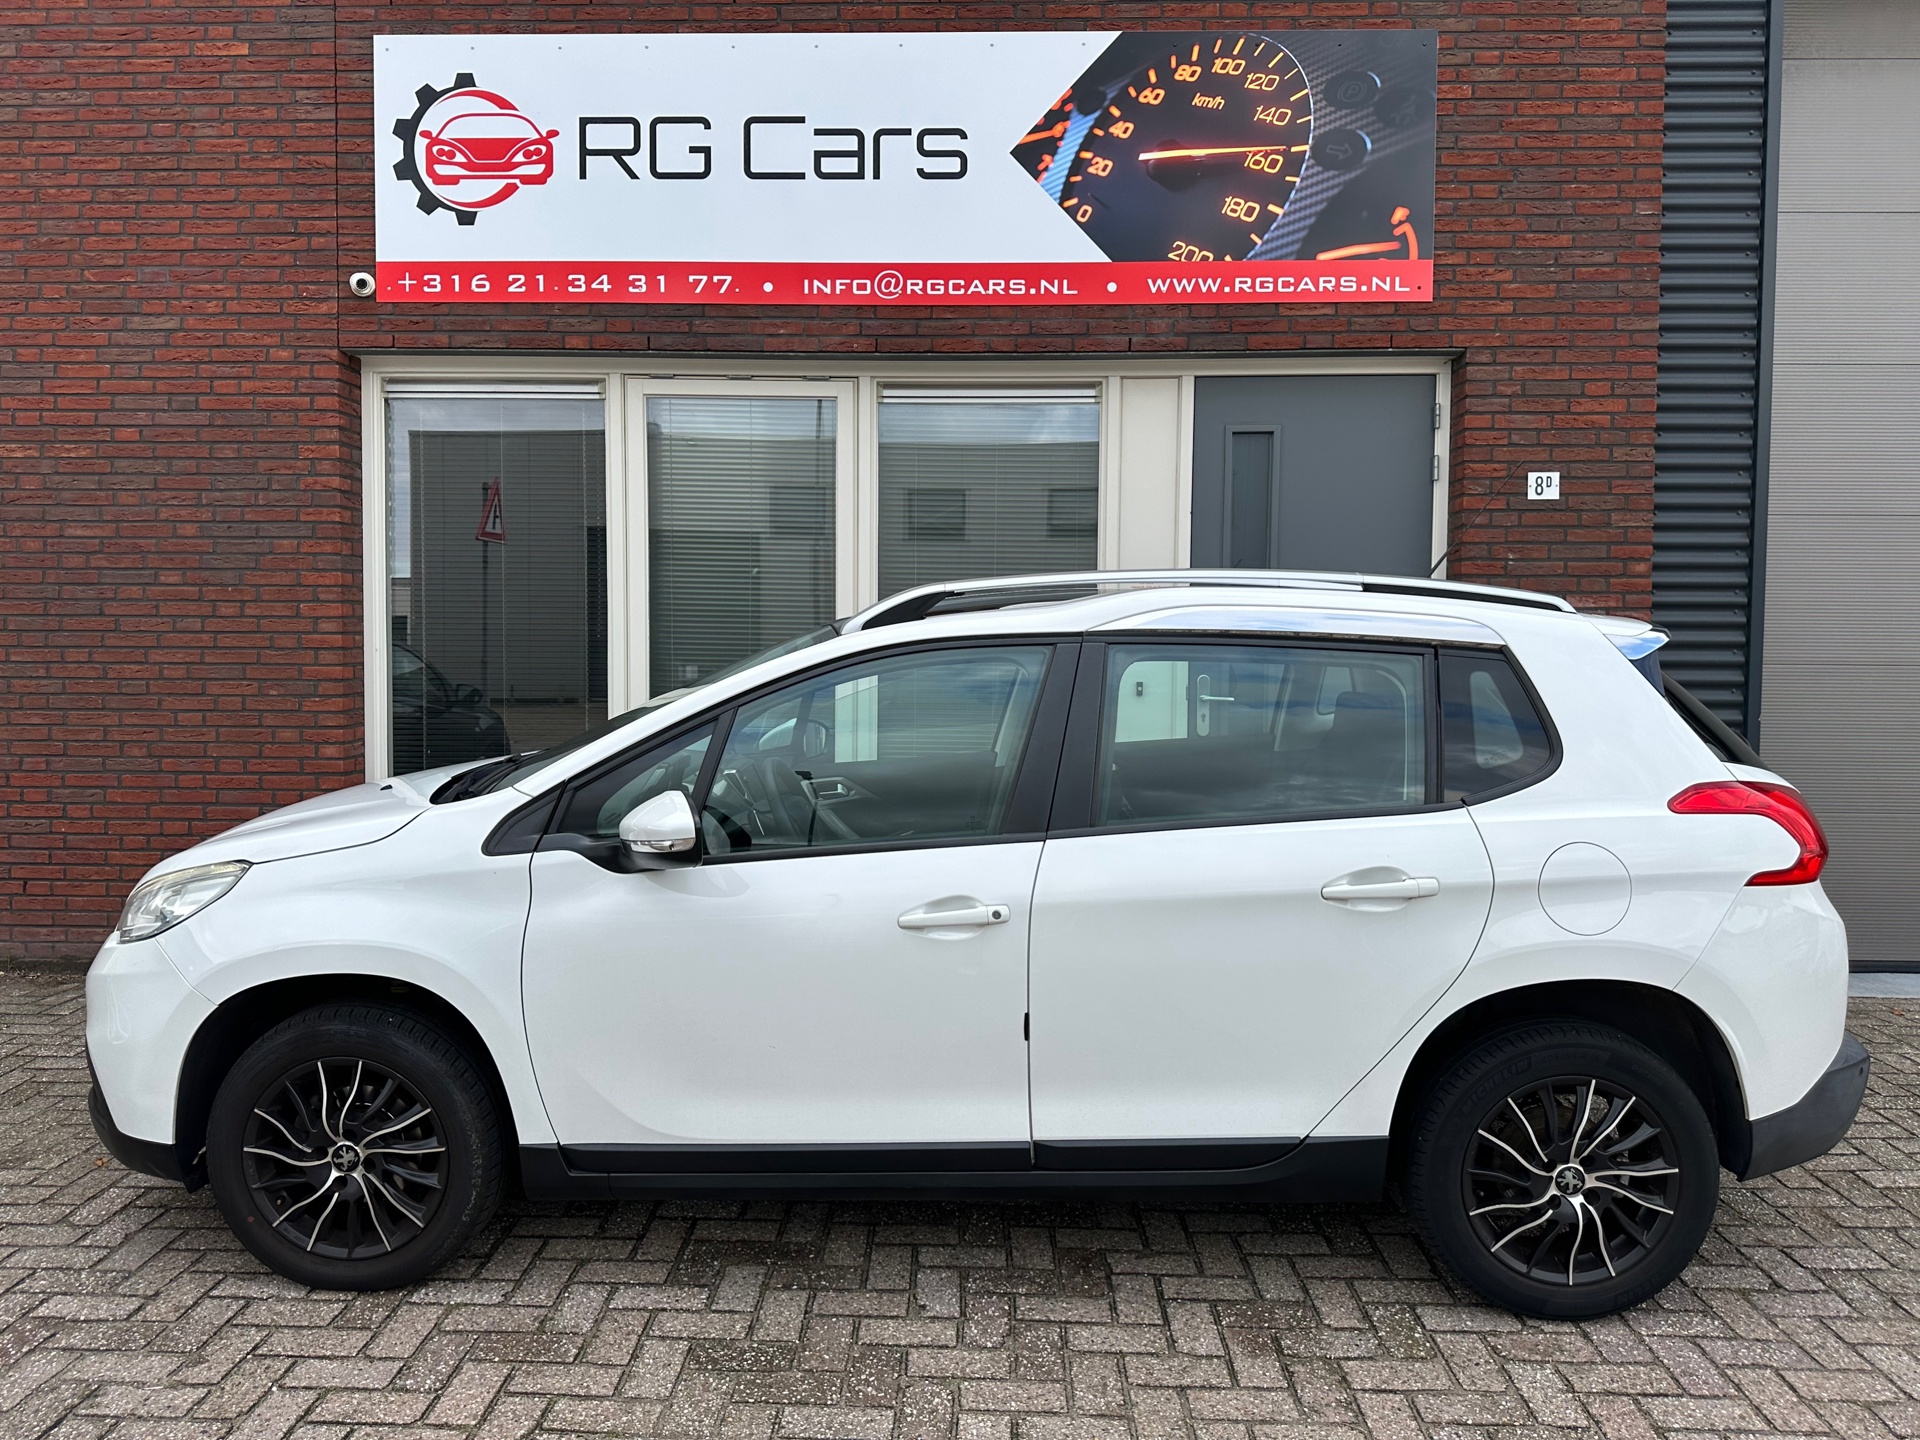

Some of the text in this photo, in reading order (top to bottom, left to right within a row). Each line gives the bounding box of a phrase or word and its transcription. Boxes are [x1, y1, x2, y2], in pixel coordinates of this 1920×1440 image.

[1174, 65, 1202, 82] 80
[1211, 57, 1246, 76] 100
[1244, 73, 1280, 91] 120
[1138, 88, 1165, 106] 60
[1192, 92, 1225, 110] km/h
[1254, 105, 1292, 126] 140
[1108, 121, 1134, 139] 40
[579, 116, 968, 180] RG Cars
[1087, 159, 1113, 177] 20
[1244, 150, 1283, 174] 160
[1076, 205, 1093, 223] 0
[1221, 195, 1260, 222] 180
[398, 272, 490, 293] +316
[628, 274, 666, 293] 31
[803, 270, 1078, 299] INFO@RGCARS.NL
[1147, 276, 1411, 294] WWW.RGCARS.NL
